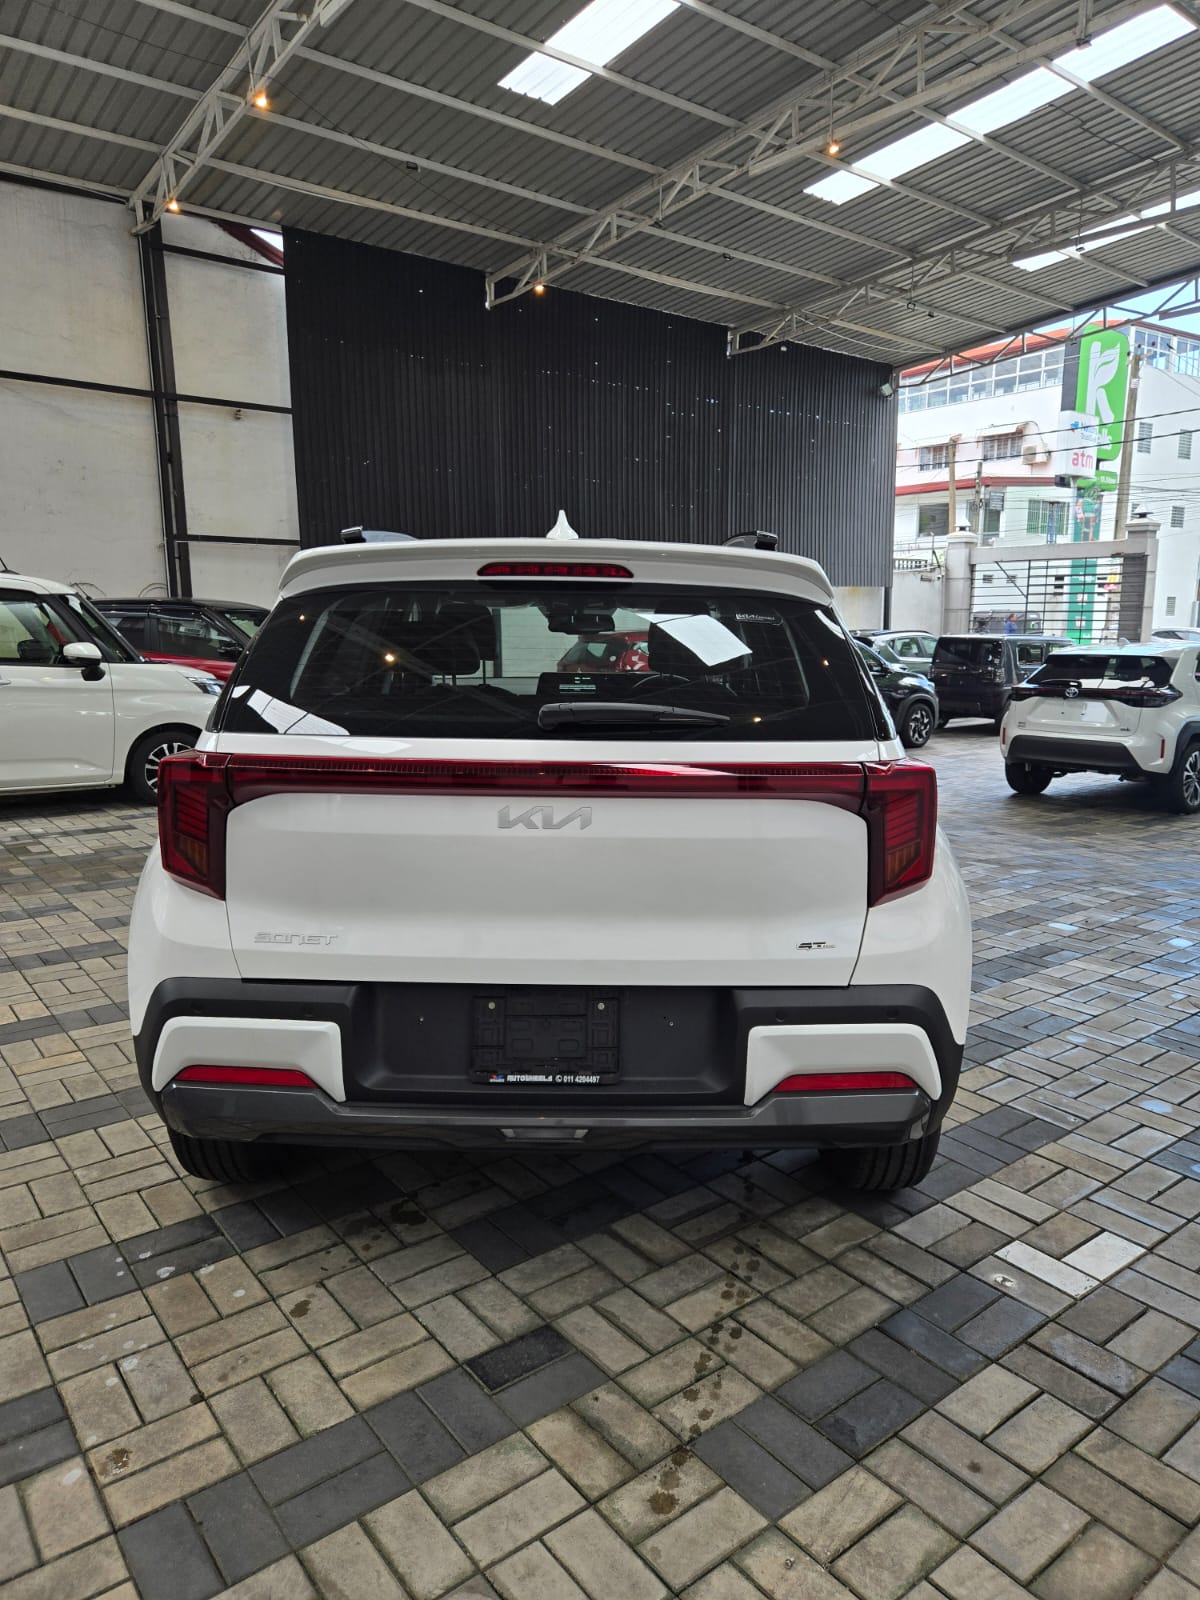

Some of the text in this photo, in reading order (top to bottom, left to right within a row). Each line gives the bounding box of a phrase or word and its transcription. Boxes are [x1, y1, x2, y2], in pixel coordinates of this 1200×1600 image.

[1071, 451, 1094, 469] atm
[497, 805, 592, 830] KIA
[254, 932, 338, 946] SONET
[563, 1075, 574, 1083] 011
